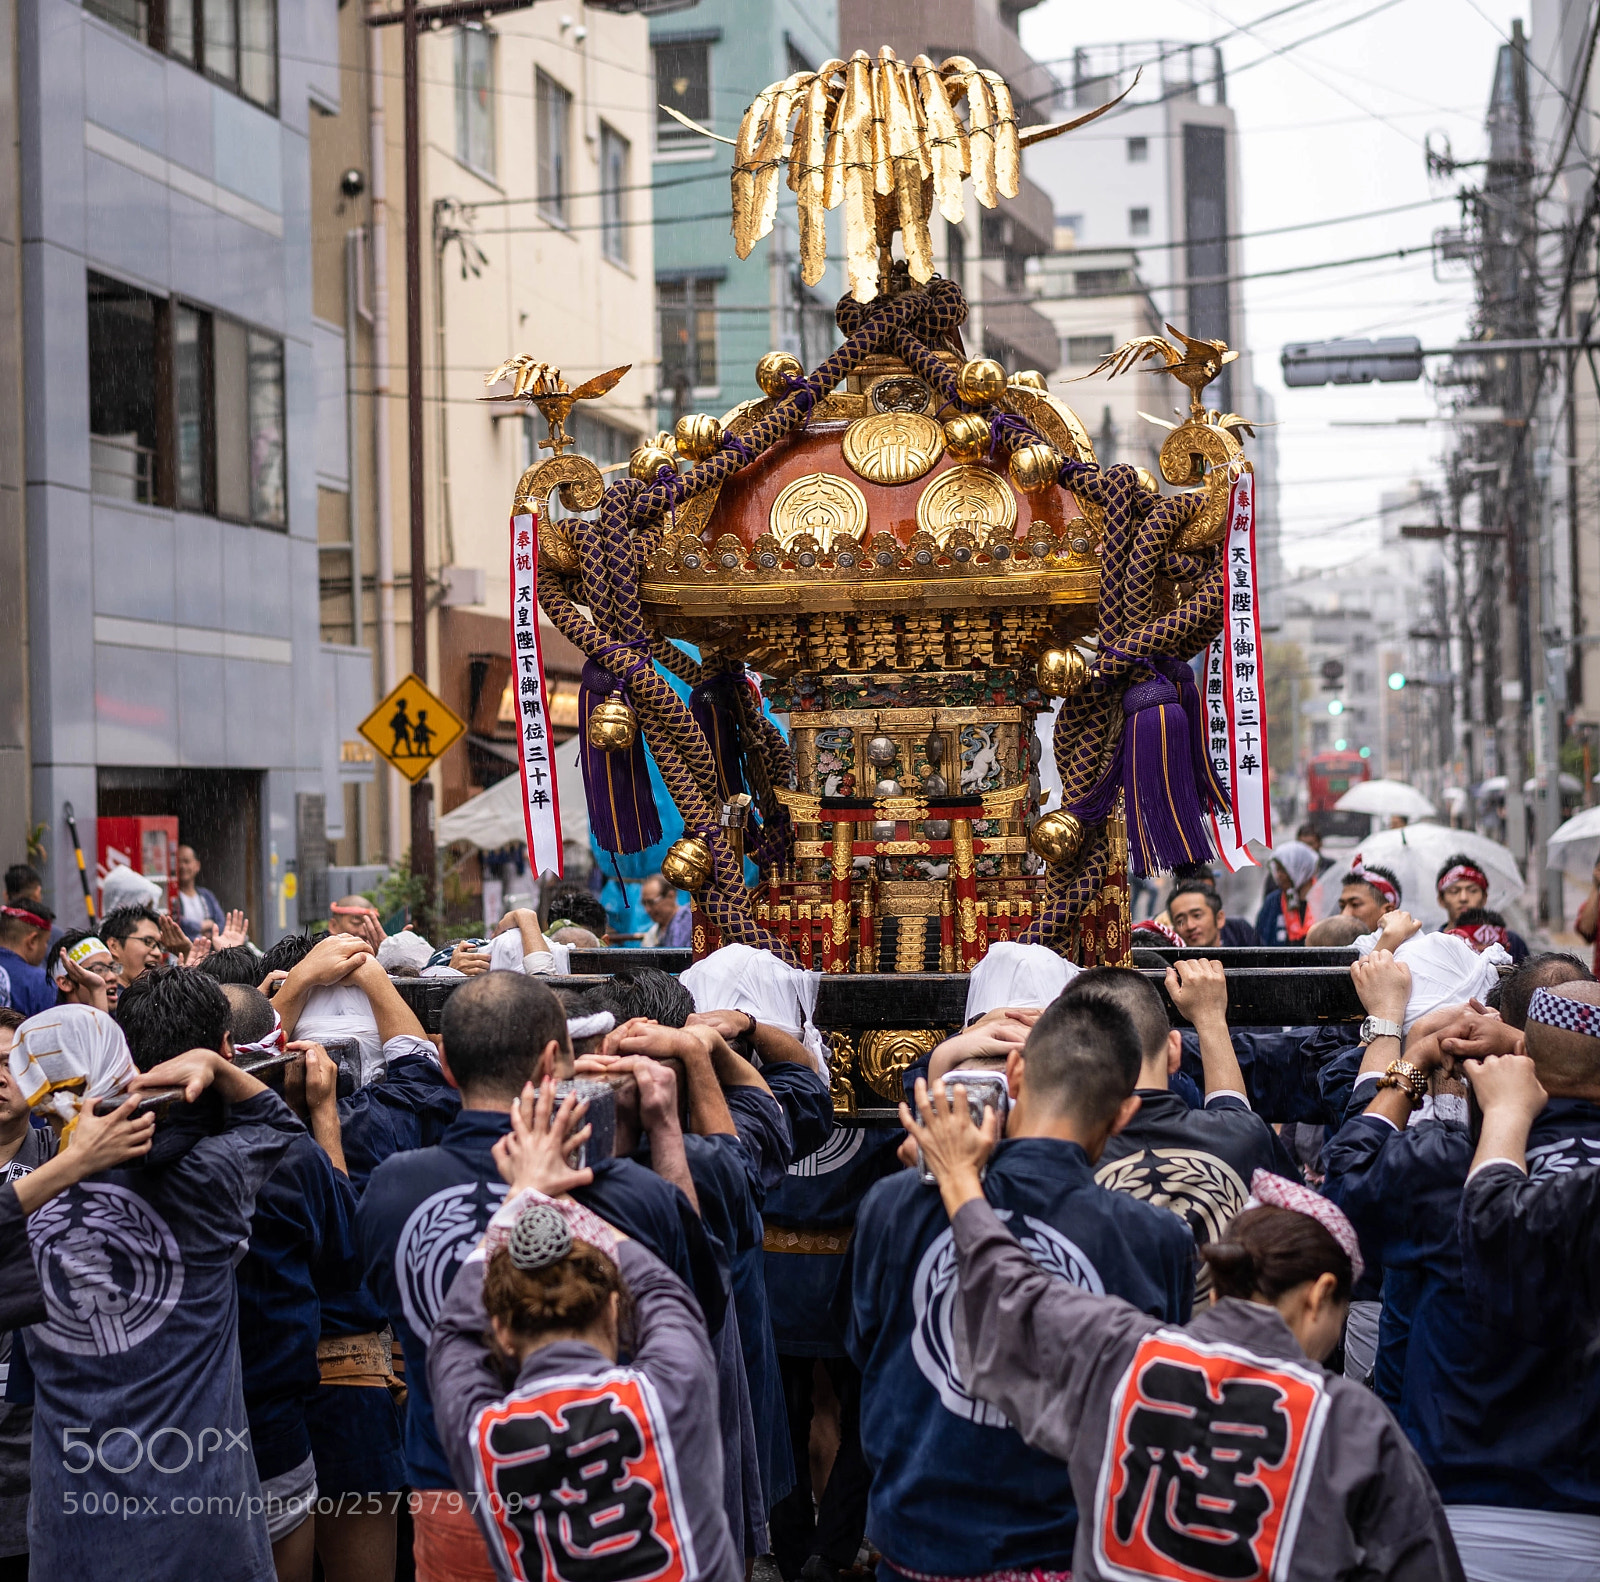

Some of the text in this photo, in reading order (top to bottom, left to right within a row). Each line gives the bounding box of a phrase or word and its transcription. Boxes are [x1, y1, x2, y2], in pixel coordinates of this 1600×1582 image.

[515, 530, 551, 809] 奉祝 天皇陛下御即位三十年
[1231, 490, 1260, 775] 奉祝 天皇陛下御即位三十年
